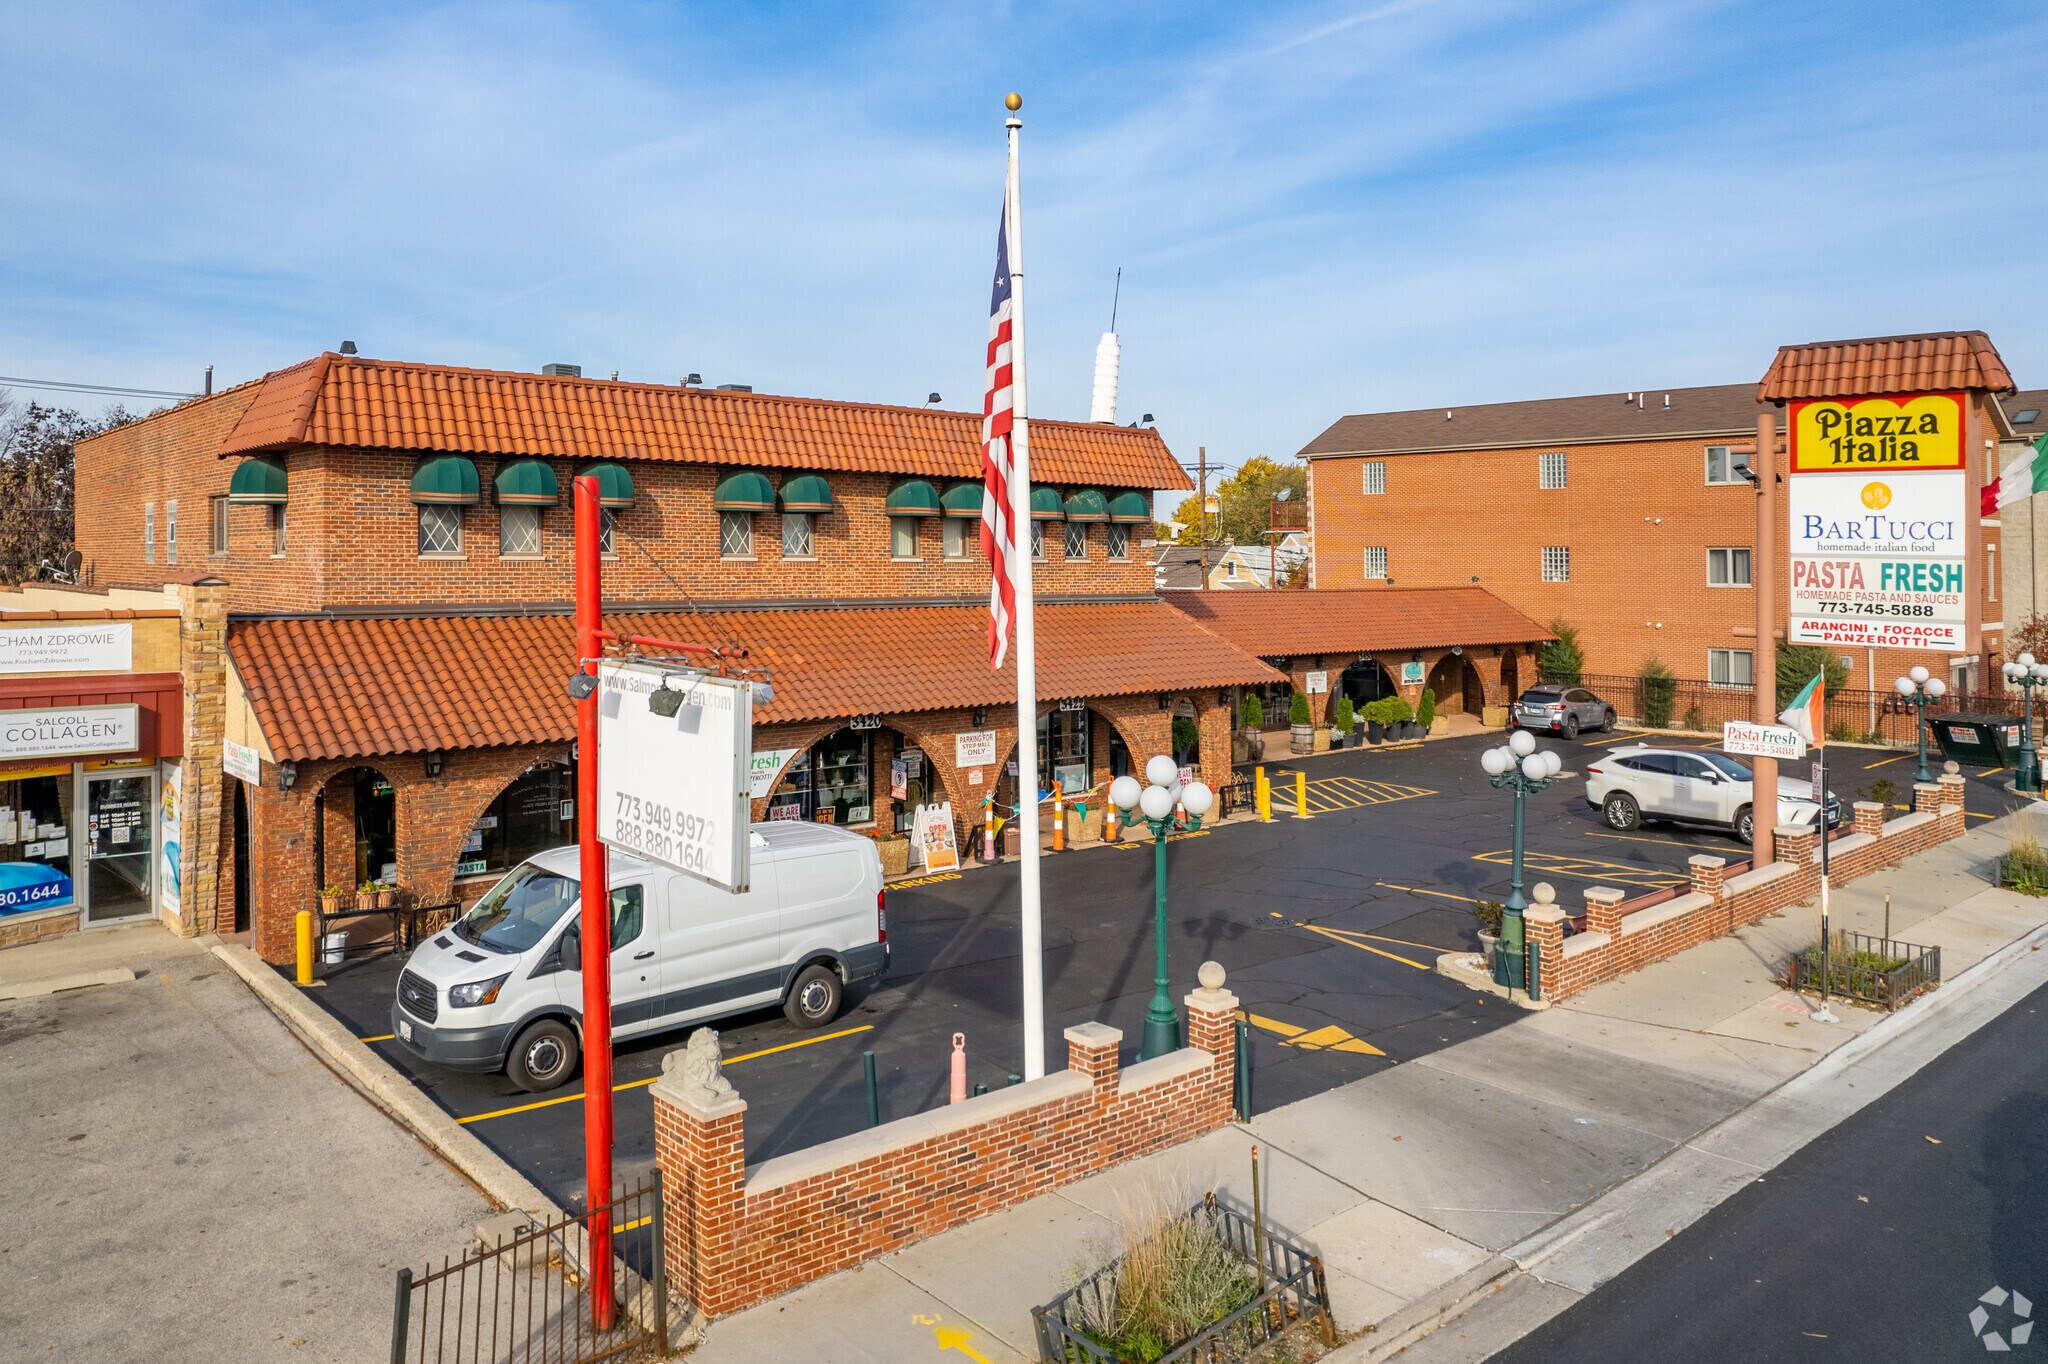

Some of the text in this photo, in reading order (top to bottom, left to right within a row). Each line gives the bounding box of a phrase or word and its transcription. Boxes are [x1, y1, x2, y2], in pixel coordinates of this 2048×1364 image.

[1815, 408, 1940, 441] Piazza
[1829, 436, 1920, 465] Italia
[1817, 541, 1935, 552] homemade italian food
[1793, 561, 1963, 593] PASTA FRESH
[1796, 590, 1959, 605] HOMEMADE PASTA AND SAUCES
[1819, 602, 1934, 617] 773-745-5888
[1801, 621, 1954, 637] ARANCINI FOCACCE
[47, 634, 115, 646] ZDROWIE
[1824, 632, 1928, 647] PANZEROTTI
[35, 716, 88, 726] SALCOLL
[960, 734, 993, 743] PARKING FOR
[1727, 726, 1797, 745] Pasta Fresh
[967, 748, 985, 756] ONLY
[1728, 741, 1795, 756] 773-745-5888
[751, 751, 780, 770] resh
[772, 805, 799, 817] WE ARE
[616, 791, 716, 847] 773.949.9972
[929, 823, 947, 832] OPEN
[615, 818, 715, 873] 888.880.1644
[457, 862, 485, 873] PASTA
